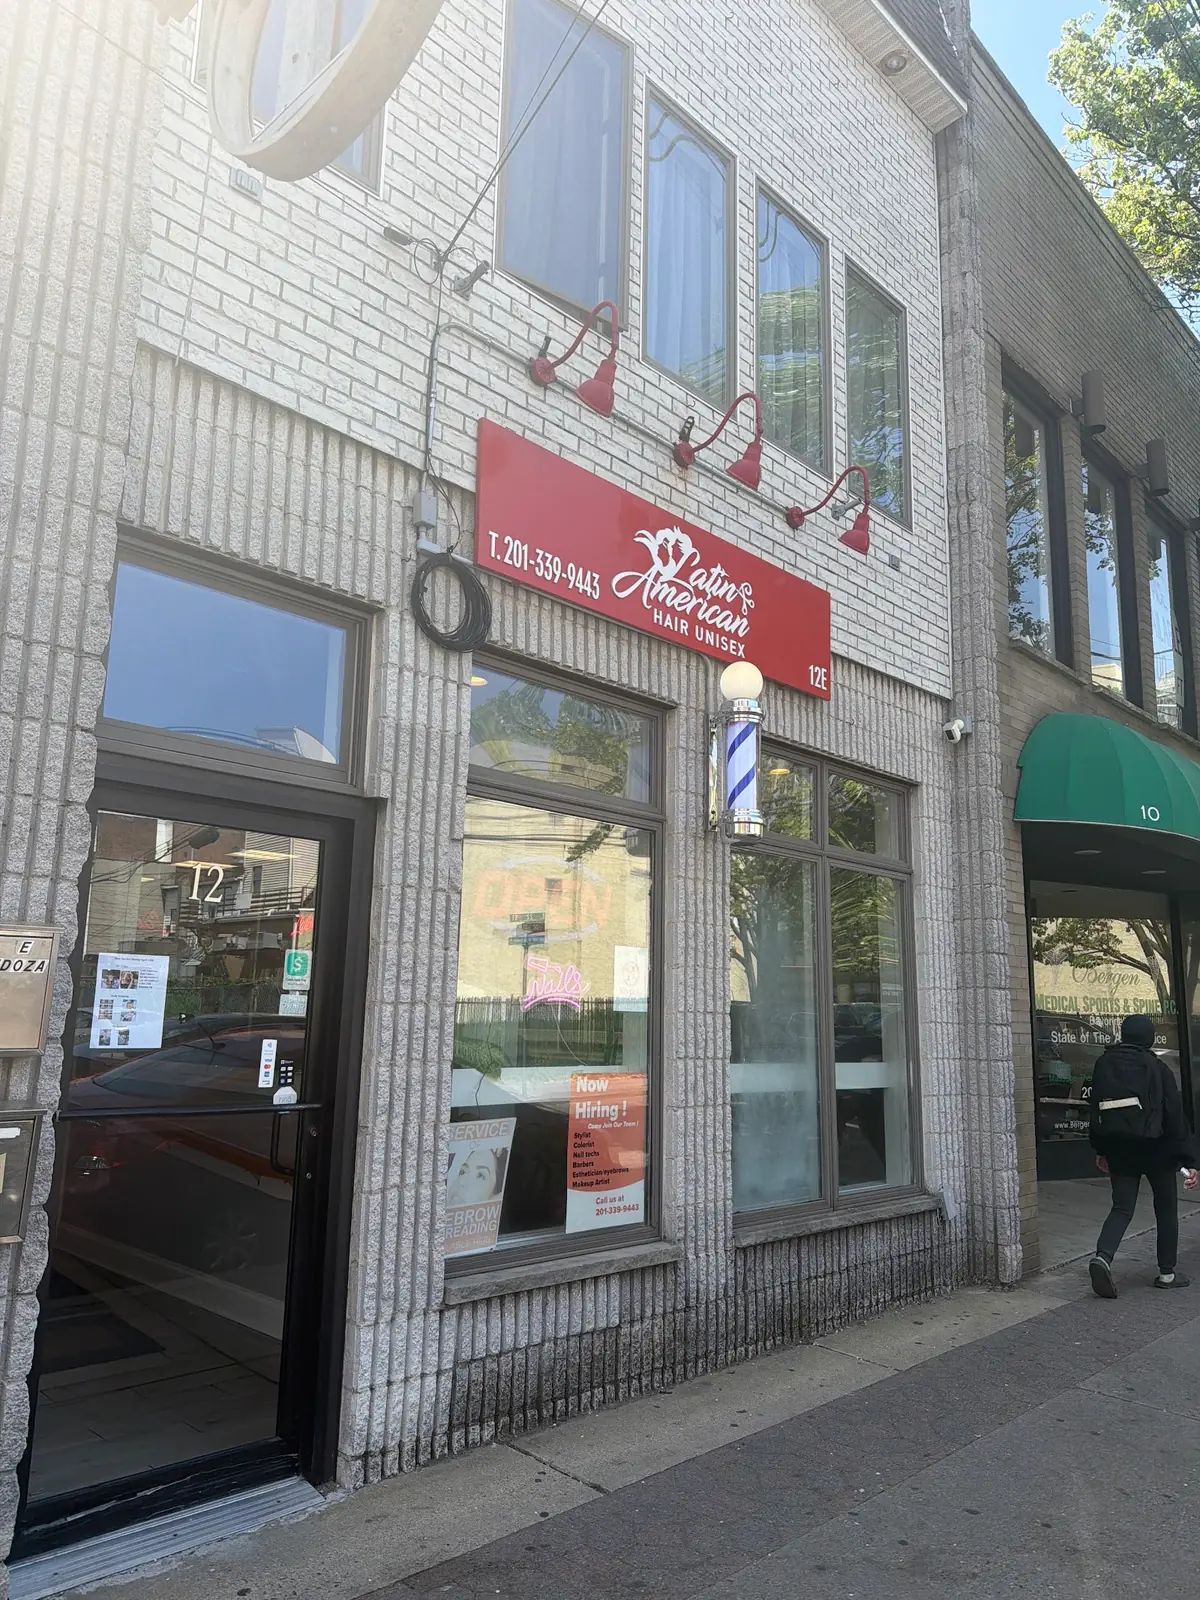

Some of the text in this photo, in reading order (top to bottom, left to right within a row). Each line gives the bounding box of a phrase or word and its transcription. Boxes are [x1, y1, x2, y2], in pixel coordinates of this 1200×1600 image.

[503, 535, 600, 600] 201-339-9443
[661, 547, 739, 603] Latin
[611, 565, 750, 638] American
[653, 608, 746, 659] HAIR UNISEX
[808, 664, 828, 691] 12E
[1141, 805, 1160, 822] 10
[188, 863, 224, 903] 12
[19, 941, 33, 953] E
[0, 959, 46, 972] DOZA
[522, 965, 590, 1002] Nails
[1072, 964, 1141, 995] Bergen
[1036, 994, 1080, 1012] MEDICAL
[1083, 996, 1120, 1013] SPORTS
[1123, 999, 1130, 1013] &
[1133, 997, 1161, 1014] SPINE
[1051, 1031, 1076, 1043] State
[1080, 1031, 1090, 1043] of
[1093, 1031, 1111, 1043] The
[576, 1076, 609, 1093] Now
[575, 1100, 619, 1121] Hiring
[602, 1121, 613, 1129] Join
[574, 1132, 591, 1140] Stylist
[573, 1141, 595, 1149] Colorist
[573, 1150, 600, 1159] Nail techs
[572, 1178, 610, 1188] Makeup Artist
[596, 1195, 608, 1204] Call
[445, 1205, 500, 1228] EBROW
[595, 1204, 640, 1216] 201-339-9443
[445, 1221, 497, 1239] READING
